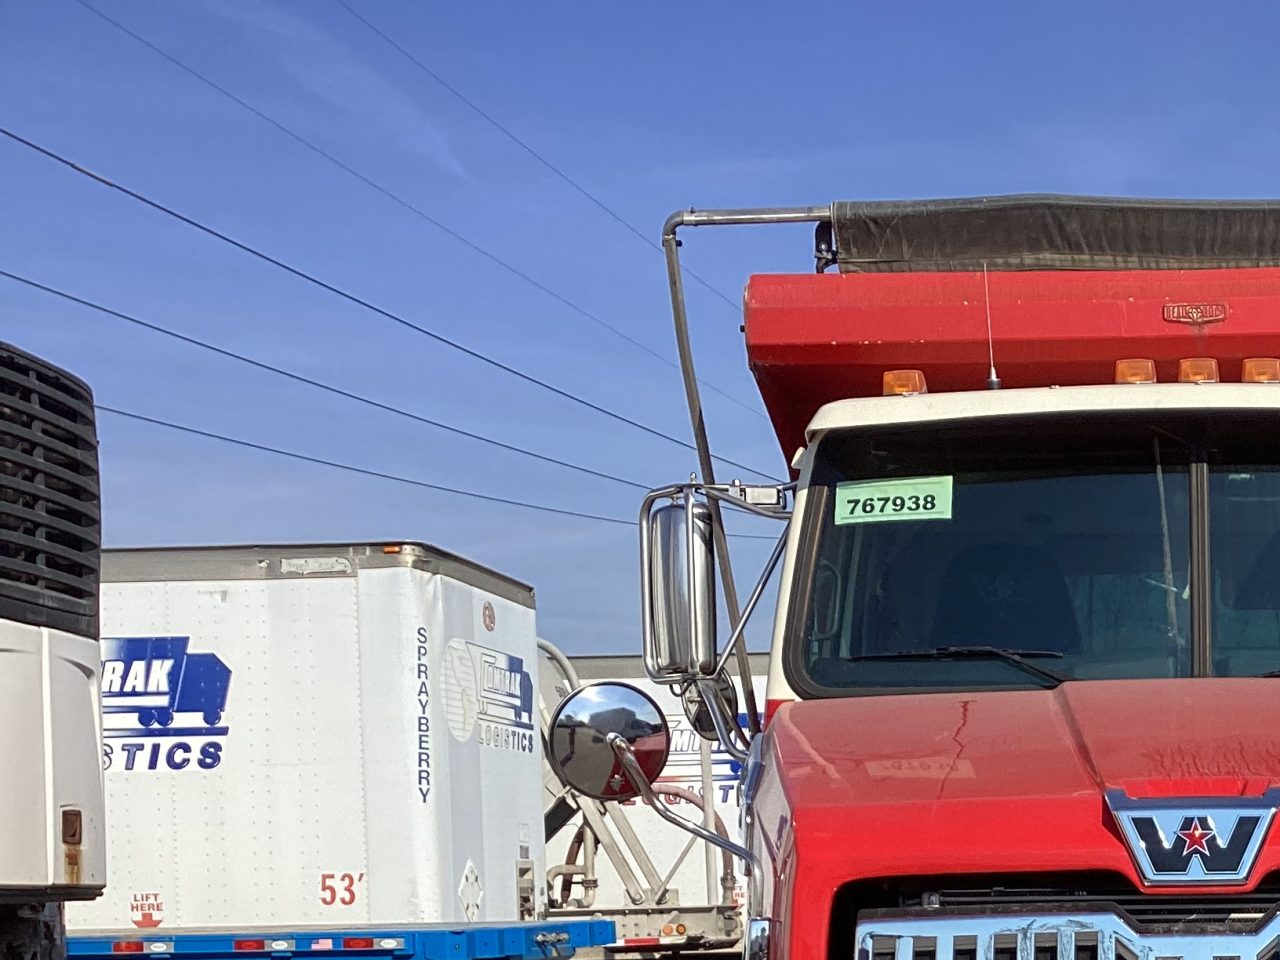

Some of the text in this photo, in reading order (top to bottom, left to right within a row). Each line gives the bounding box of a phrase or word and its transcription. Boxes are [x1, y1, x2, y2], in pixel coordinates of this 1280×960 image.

[846, 494, 937, 515] 767938
[101, 659, 175, 693] RAK
[417, 627, 431, 803] SPRAYBERRY
[477, 722, 534, 754] LOGISTICS
[130, 902, 164, 912] HERE
[133, 893, 160, 902] LIFT
